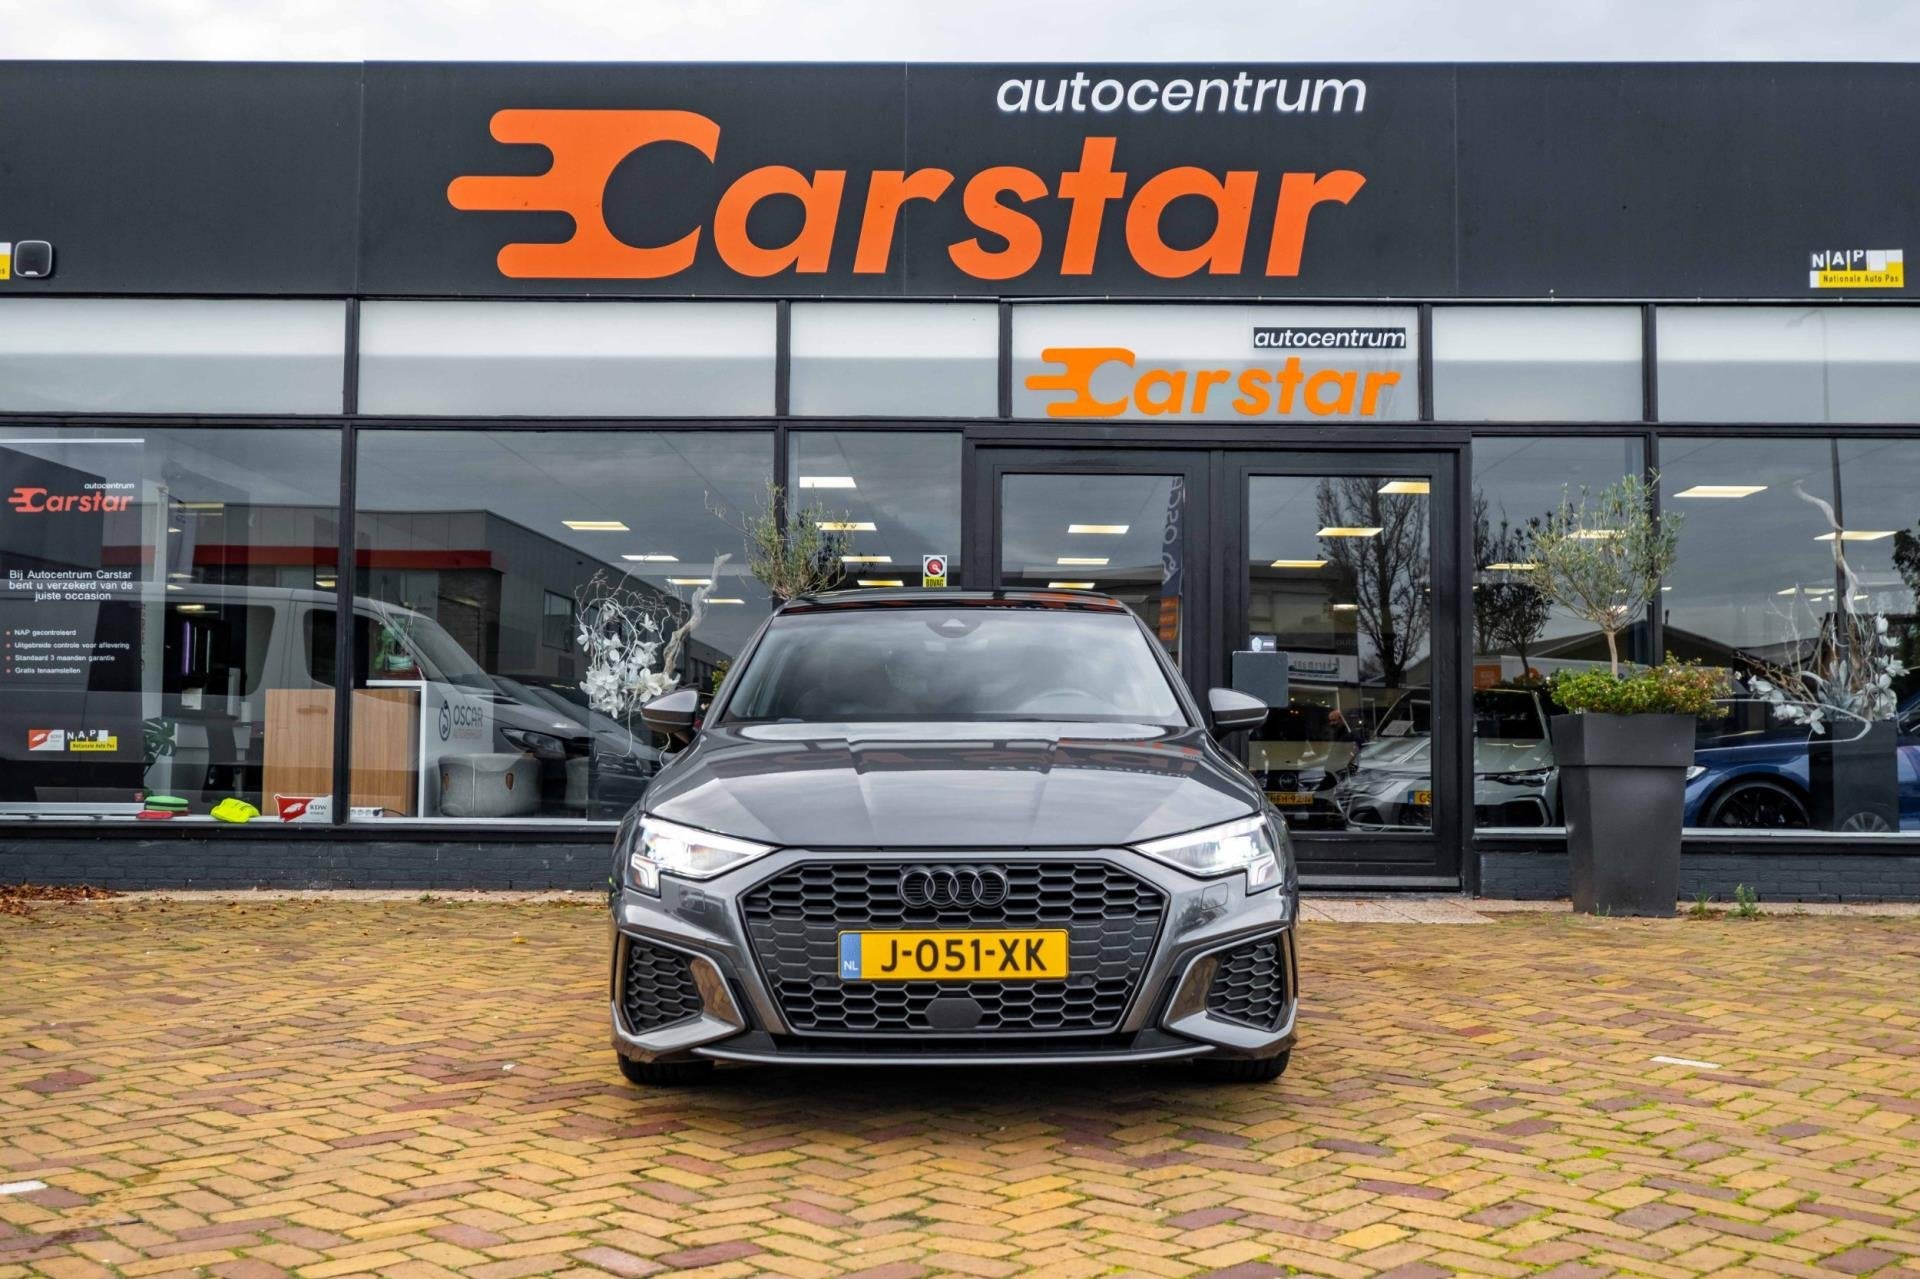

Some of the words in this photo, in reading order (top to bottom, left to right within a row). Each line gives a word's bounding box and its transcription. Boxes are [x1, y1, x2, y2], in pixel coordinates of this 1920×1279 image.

[996, 72, 1367, 113] autocentrum
[447, 108, 1367, 280] Carstar
[1823, 275, 1861, 283] Nationale
[1864, 275, 1882, 283] Auto
[1885, 274, 1899, 282] Pas
[1255, 329, 1406, 347] autocentrum
[1025, 347, 1400, 417] Carstar
[8, 488, 134, 513] Carstar
[9, 570, 23, 580] Bij
[27, 570, 92, 579] Autocentrum
[96, 570, 132, 579] Carstar
[9, 581, 33, 590] bent
[47, 581, 96, 590] verzekerd
[121, 581, 133, 590] de
[35, 591, 61, 602] juiste
[65, 592, 111, 600] occasion
[32, 629, 77, 637] gecontroleerd
[98, 642, 130, 650] aflevering
[453, 705, 483, 728] OSCAR
[844, 961, 858, 971] NL
[881, 939, 1047, 972] J-051-XK
